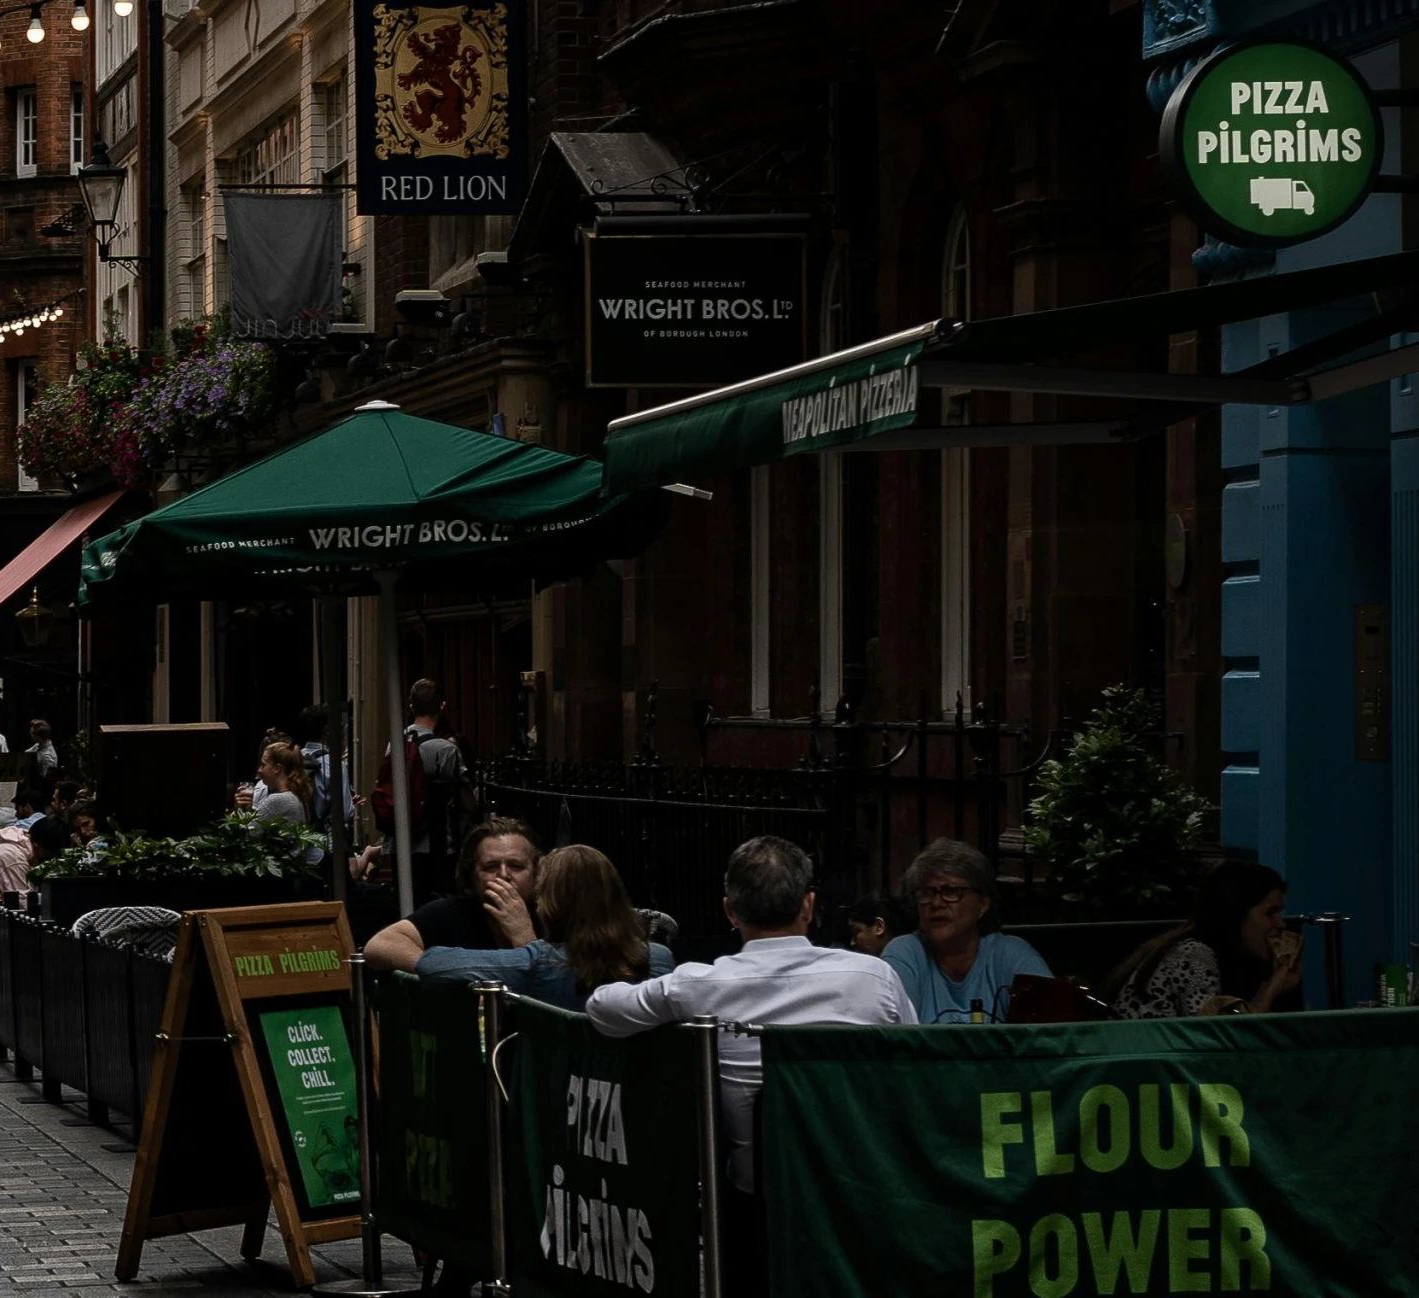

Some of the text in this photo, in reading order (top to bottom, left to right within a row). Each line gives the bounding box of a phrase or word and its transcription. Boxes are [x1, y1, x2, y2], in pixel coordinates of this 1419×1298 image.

[1231, 81, 1329, 115] PIZZA
[381, 175, 507, 201] RED LION
[644, 281, 747, 289] SEAFOOD MERCHANT
[598, 299, 696, 320] WRIGHT
[701, 299, 770, 320] BROS.
[643, 330, 749, 338] OF BOROUGH LONDON
[185, 541, 235, 555] SEAFOOD
[238, 537, 295, 549] MERCHANT
[308, 524, 415, 549] WRIGHT
[418, 519, 487, 544] BROS.
[235, 954, 275, 977] PIZZA
[287, 1046, 336, 1067] COLLECT.
[566, 1074, 629, 1166] PIZZA
[980, 1082, 1252, 1179] FLOUR
[971, 1206, 1272, 1298] POWER
